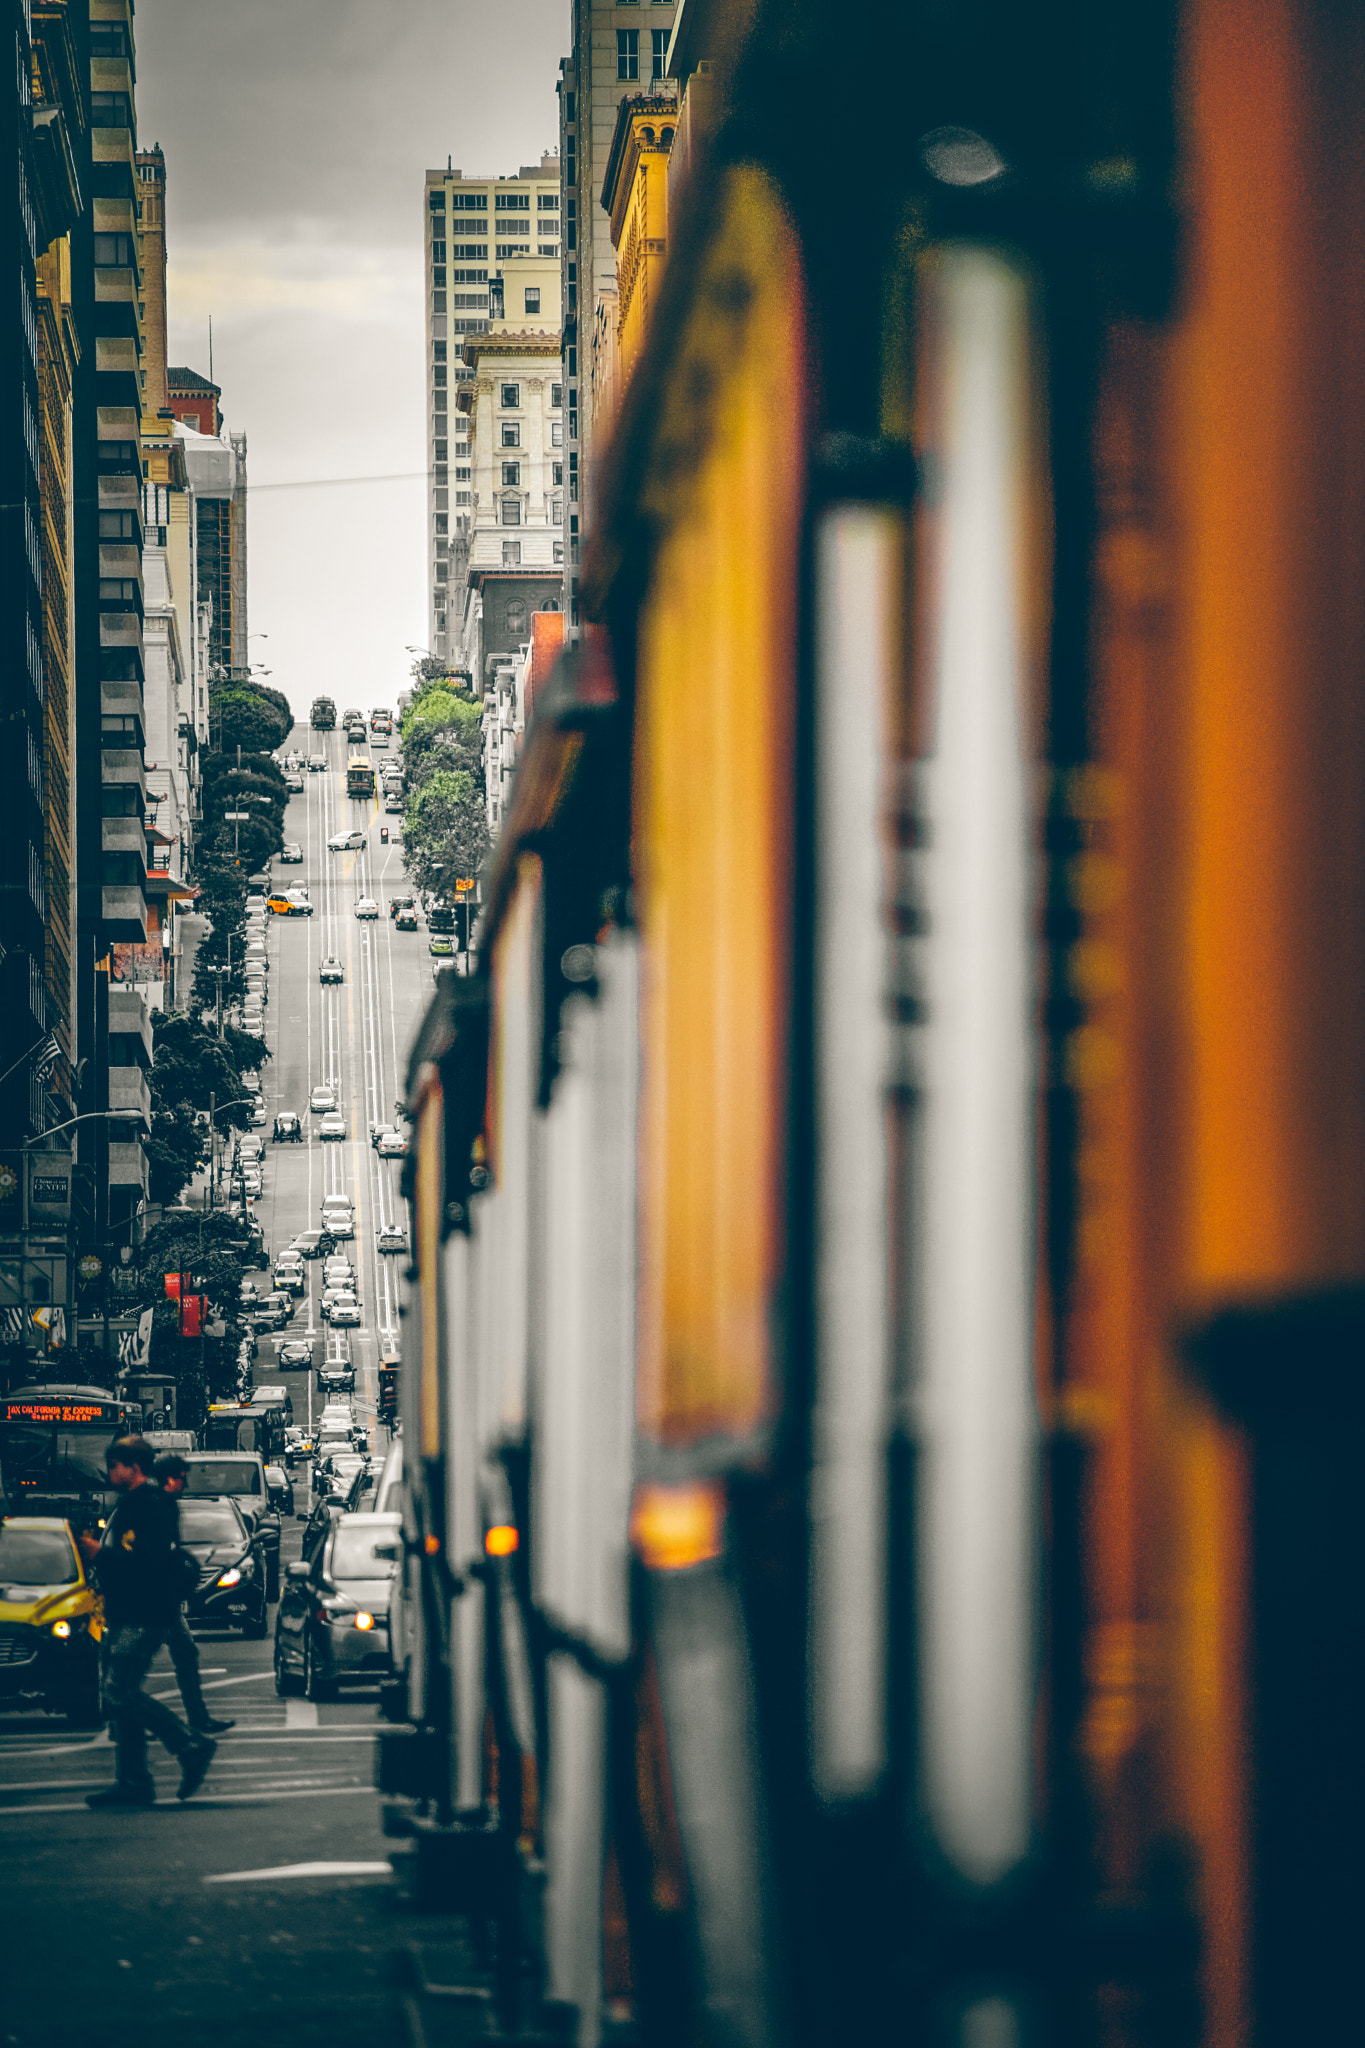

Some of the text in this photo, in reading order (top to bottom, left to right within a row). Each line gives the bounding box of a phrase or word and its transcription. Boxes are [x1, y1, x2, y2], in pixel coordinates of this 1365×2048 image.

[81, 1262, 99, 1271] 50
[22, 1406, 60, 1414] CALIFORNIA
[72, 1406, 102, 1416] EXPRESS
